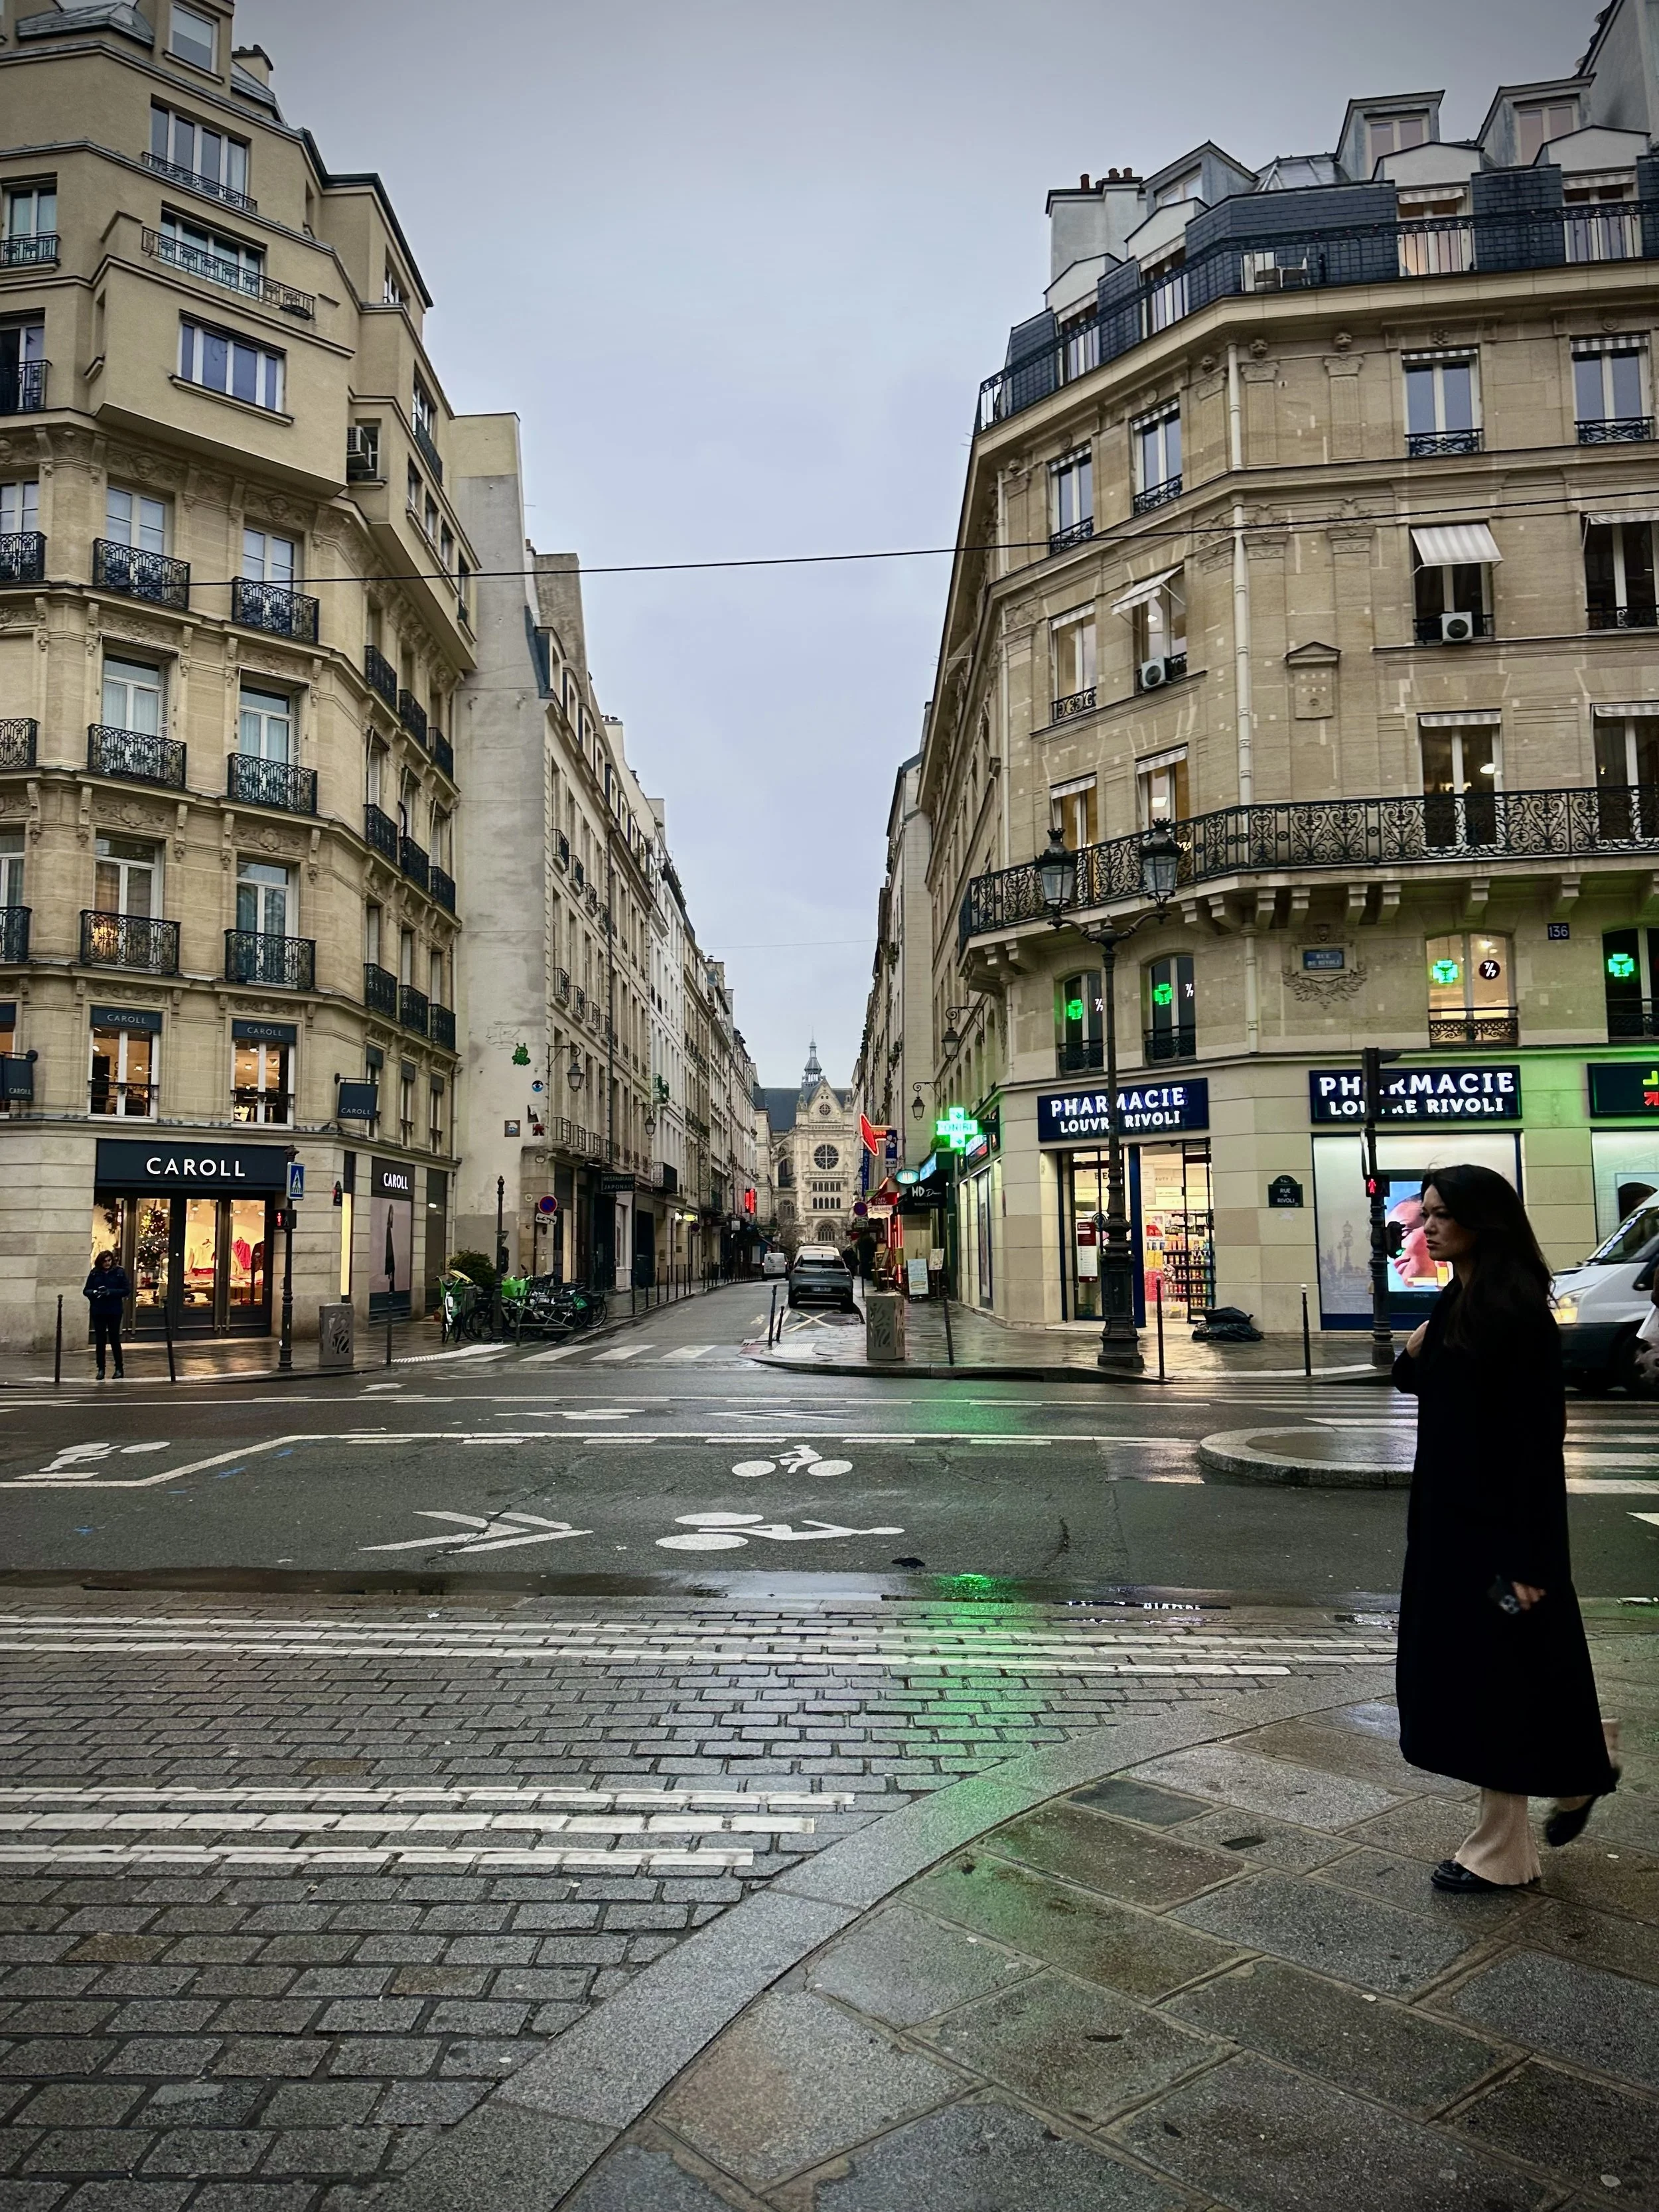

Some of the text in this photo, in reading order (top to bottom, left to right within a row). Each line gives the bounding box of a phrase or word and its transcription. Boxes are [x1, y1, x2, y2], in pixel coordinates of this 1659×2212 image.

[1549, 926, 1568, 938] 136
[107, 1013, 147, 1024] CAROLL
[247, 1027, 283, 1037] CAROLL
[1319, 1072, 1514, 1096] PHRMACIE
[1426, 1097, 1504, 1114] RIVOLI
[1060, 1110, 1181, 1134] LOUVR RIVOLI
[146, 1157, 246, 1177] CAROLL
[383, 1172, 409, 1190] CAROLL
[912, 1185, 925, 1197] HD
